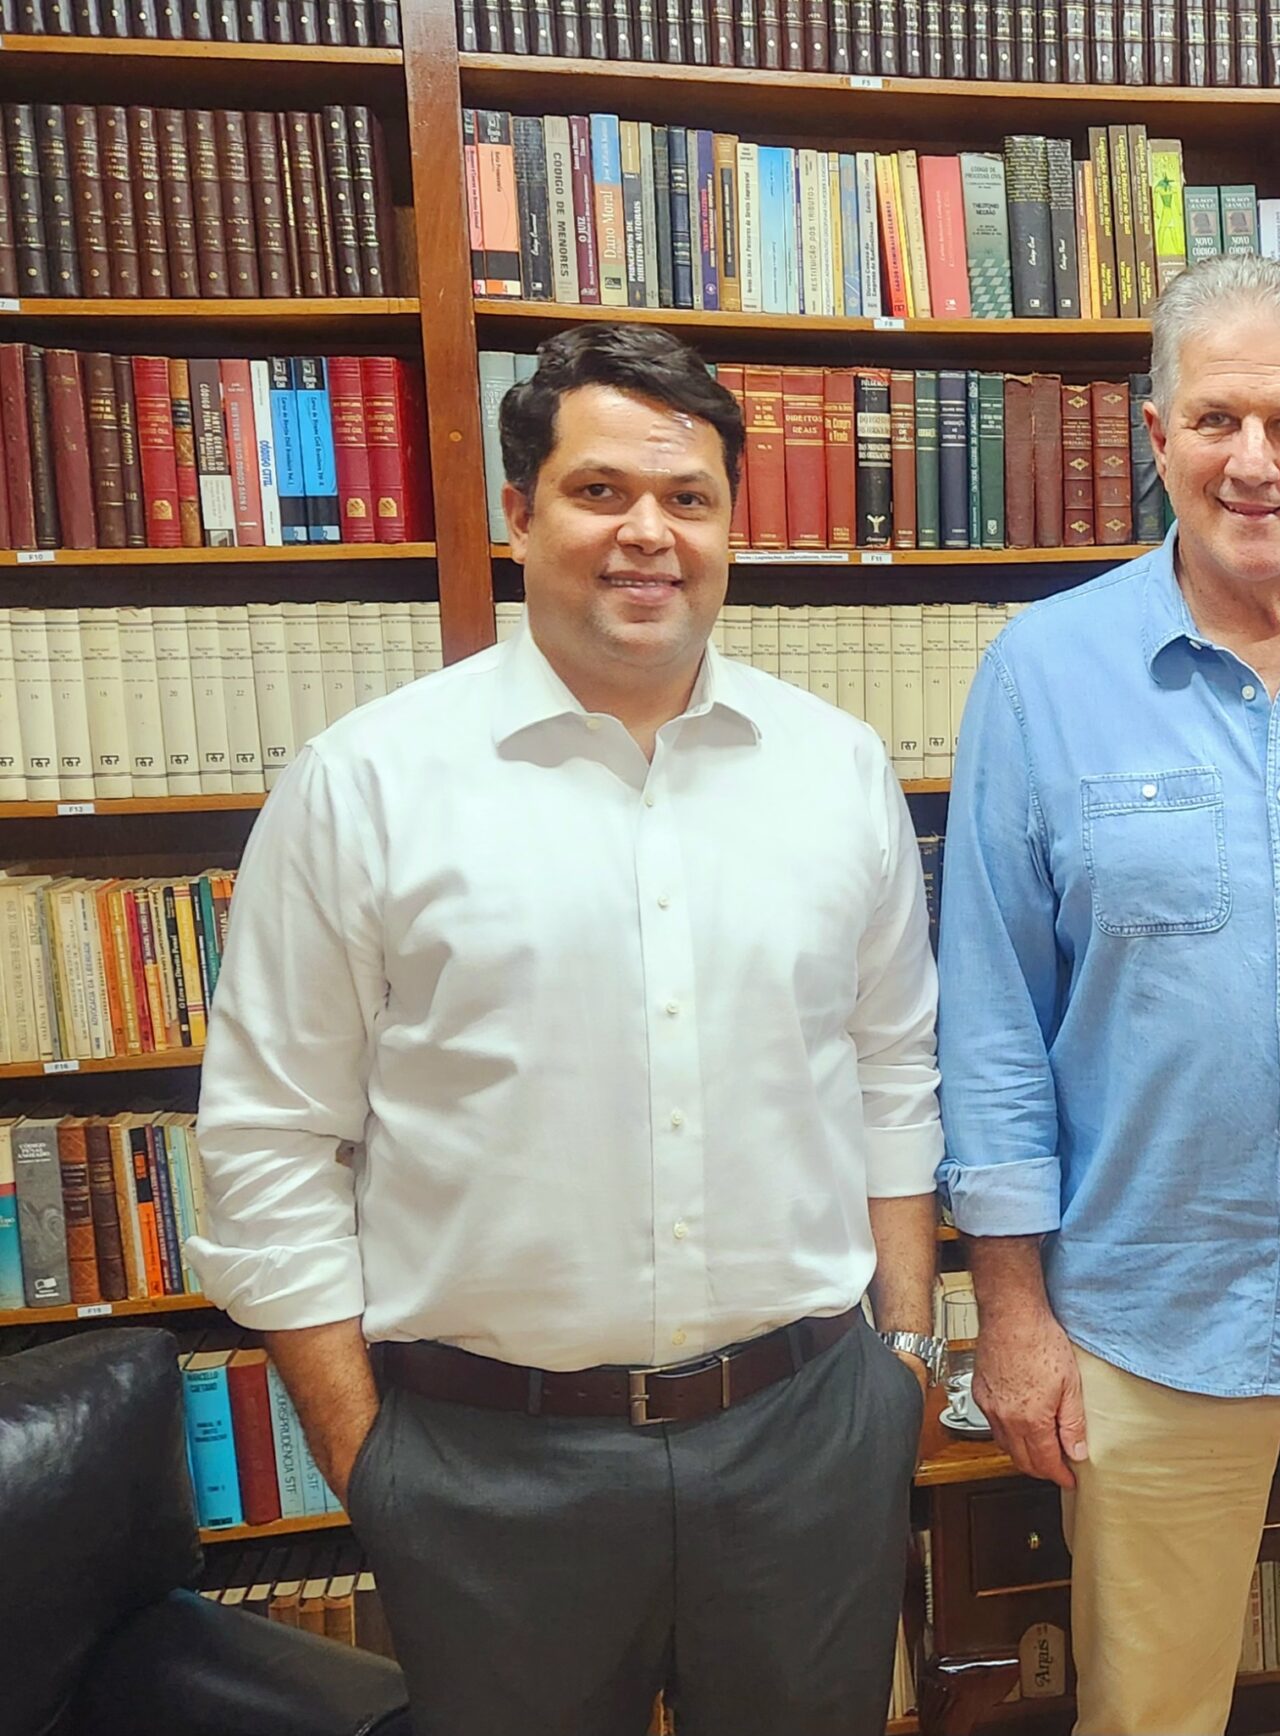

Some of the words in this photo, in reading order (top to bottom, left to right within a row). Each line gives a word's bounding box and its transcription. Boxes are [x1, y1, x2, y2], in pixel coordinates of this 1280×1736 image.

[556, 201, 566, 215] DE
[599, 191, 614, 224] Moral
[557, 221, 569, 277] MENORES
[602, 227, 617, 259] Dano
[1194, 237, 1214, 245] NOVO
[1231, 236, 1250, 245] NOVO
[635, 243, 645, 282] DIREITOS
[200, 383, 213, 408] CÓDIGO
[202, 410, 213, 430] PENAL
[785, 414, 823, 422] DIREITOS
[204, 433, 215, 471] BRASILEIRO
[260, 440, 272, 467] CÓDIGO
[263, 468, 273, 486] CIVIL
[171, 934, 180, 953] Penal
[173, 955, 183, 977] Direito
[285, 1476, 297, 1495] STF
[307, 1474, 319, 1491] STF
